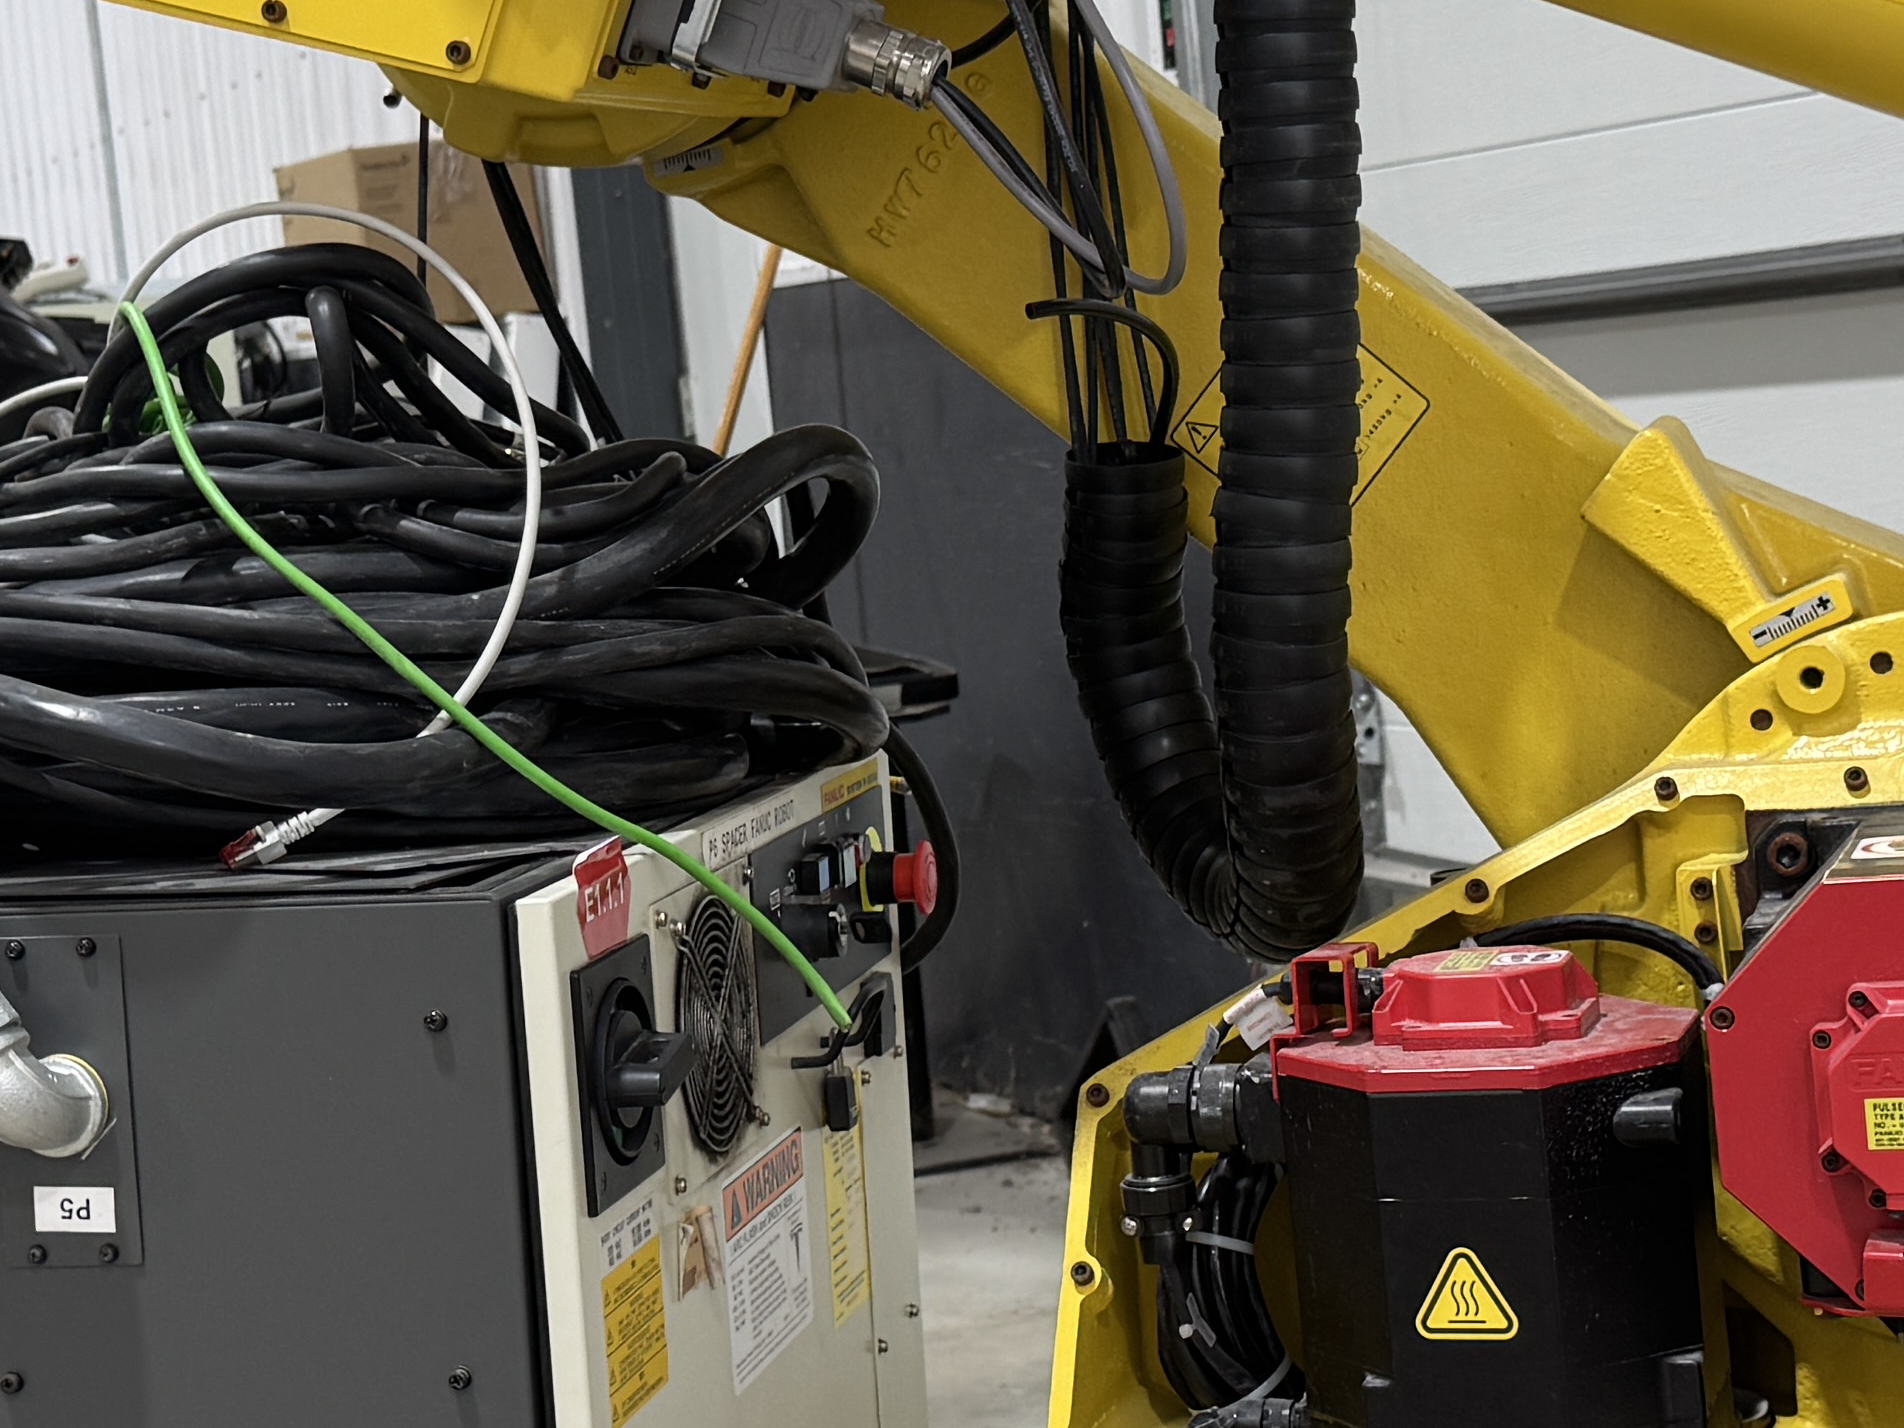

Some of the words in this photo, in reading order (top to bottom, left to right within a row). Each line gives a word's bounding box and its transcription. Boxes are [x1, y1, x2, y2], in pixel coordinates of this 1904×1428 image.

[721, 823, 748, 854] SPACER
[751, 809, 771, 839] FANUC
[774, 799, 794, 829] ROBOT
[584, 871, 625, 924] E1.1.1
[742, 1140, 800, 1214] WARNING
[59, 1198, 91, 1221] P5
